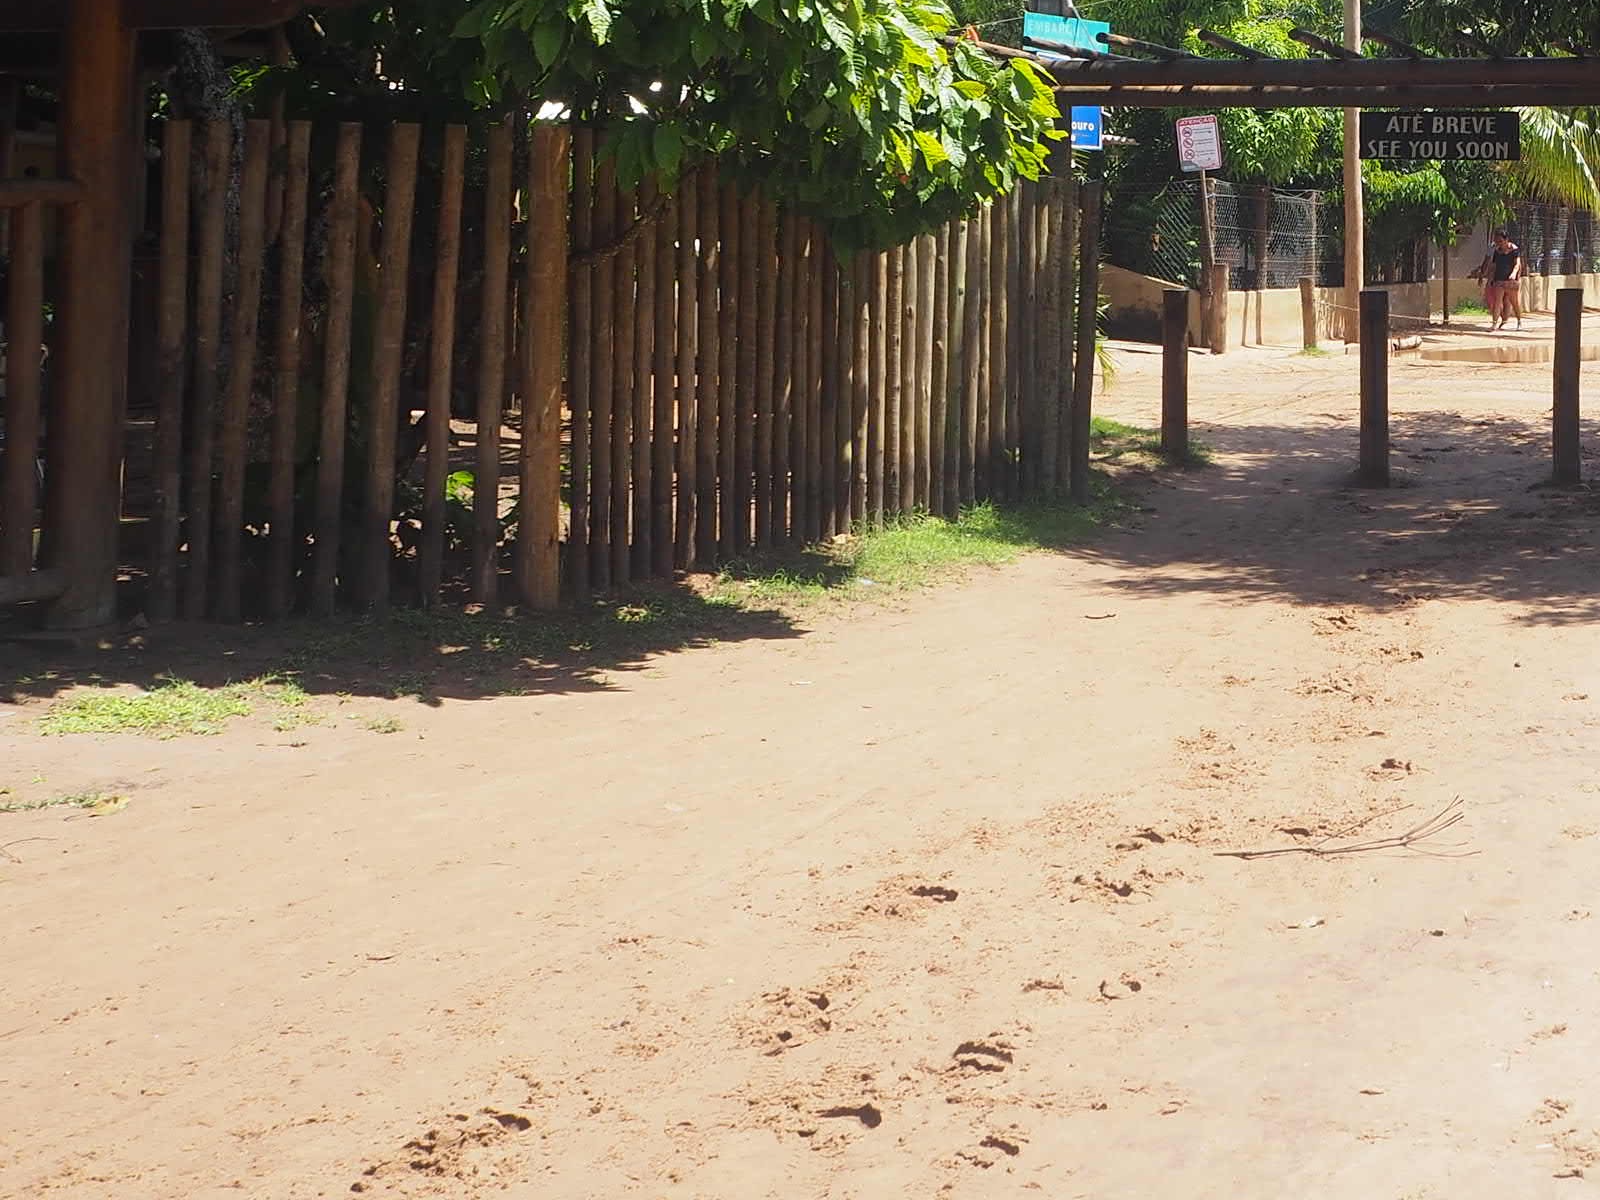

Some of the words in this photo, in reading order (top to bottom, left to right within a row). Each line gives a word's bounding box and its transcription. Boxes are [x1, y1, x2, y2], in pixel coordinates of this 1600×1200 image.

[1386, 113, 1424, 134] ATÉ
[1432, 116, 1497, 134] BREVE
[1368, 139, 1401, 158] SEE
[1408, 140, 1447, 159] YOU
[1456, 141, 1509, 160] SOON
